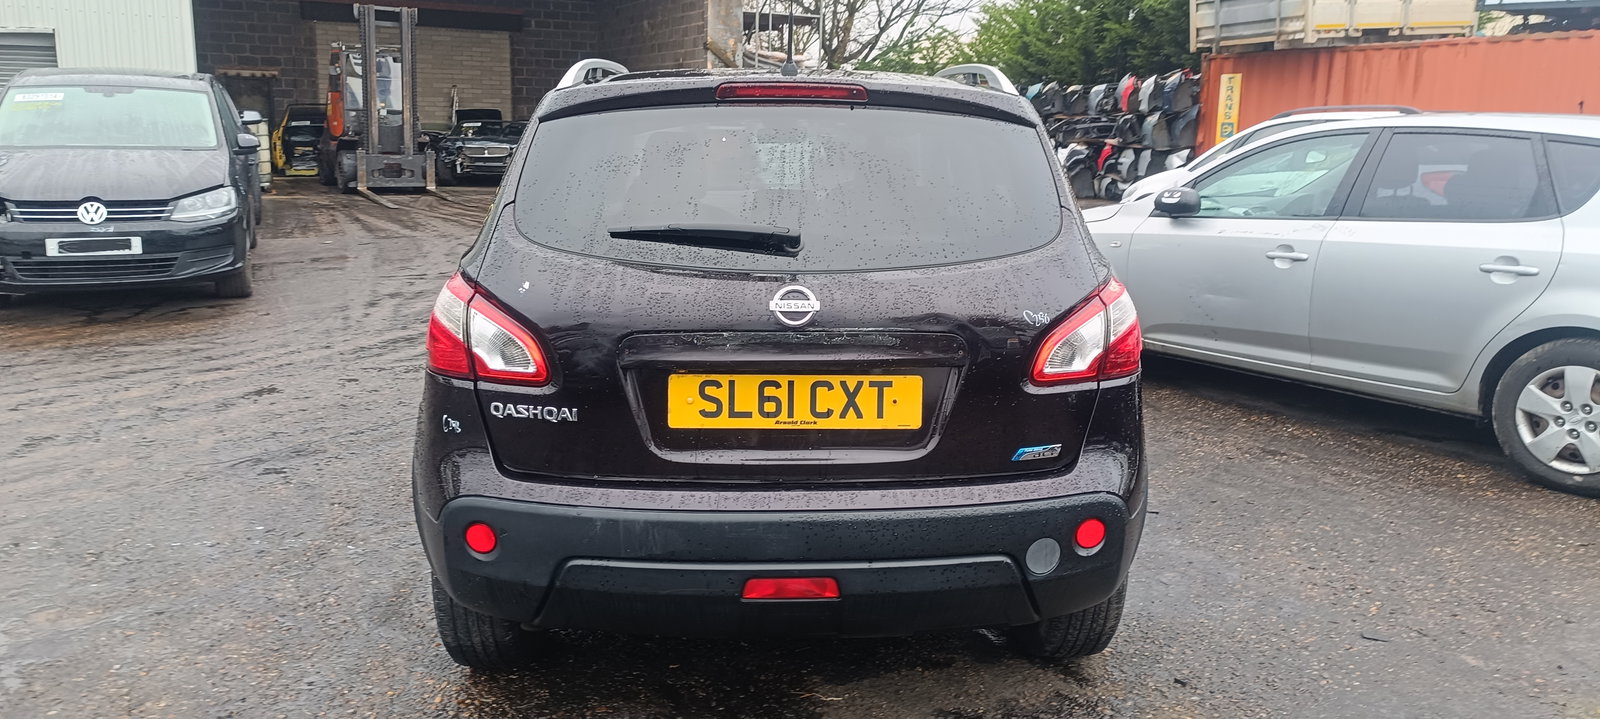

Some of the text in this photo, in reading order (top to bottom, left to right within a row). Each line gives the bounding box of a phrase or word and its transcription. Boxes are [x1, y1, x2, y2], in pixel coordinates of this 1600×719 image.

[775, 302, 815, 310] NISSAN
[698, 379, 893, 419] SL61 CXT
[490, 402, 578, 423] QASHQAI
